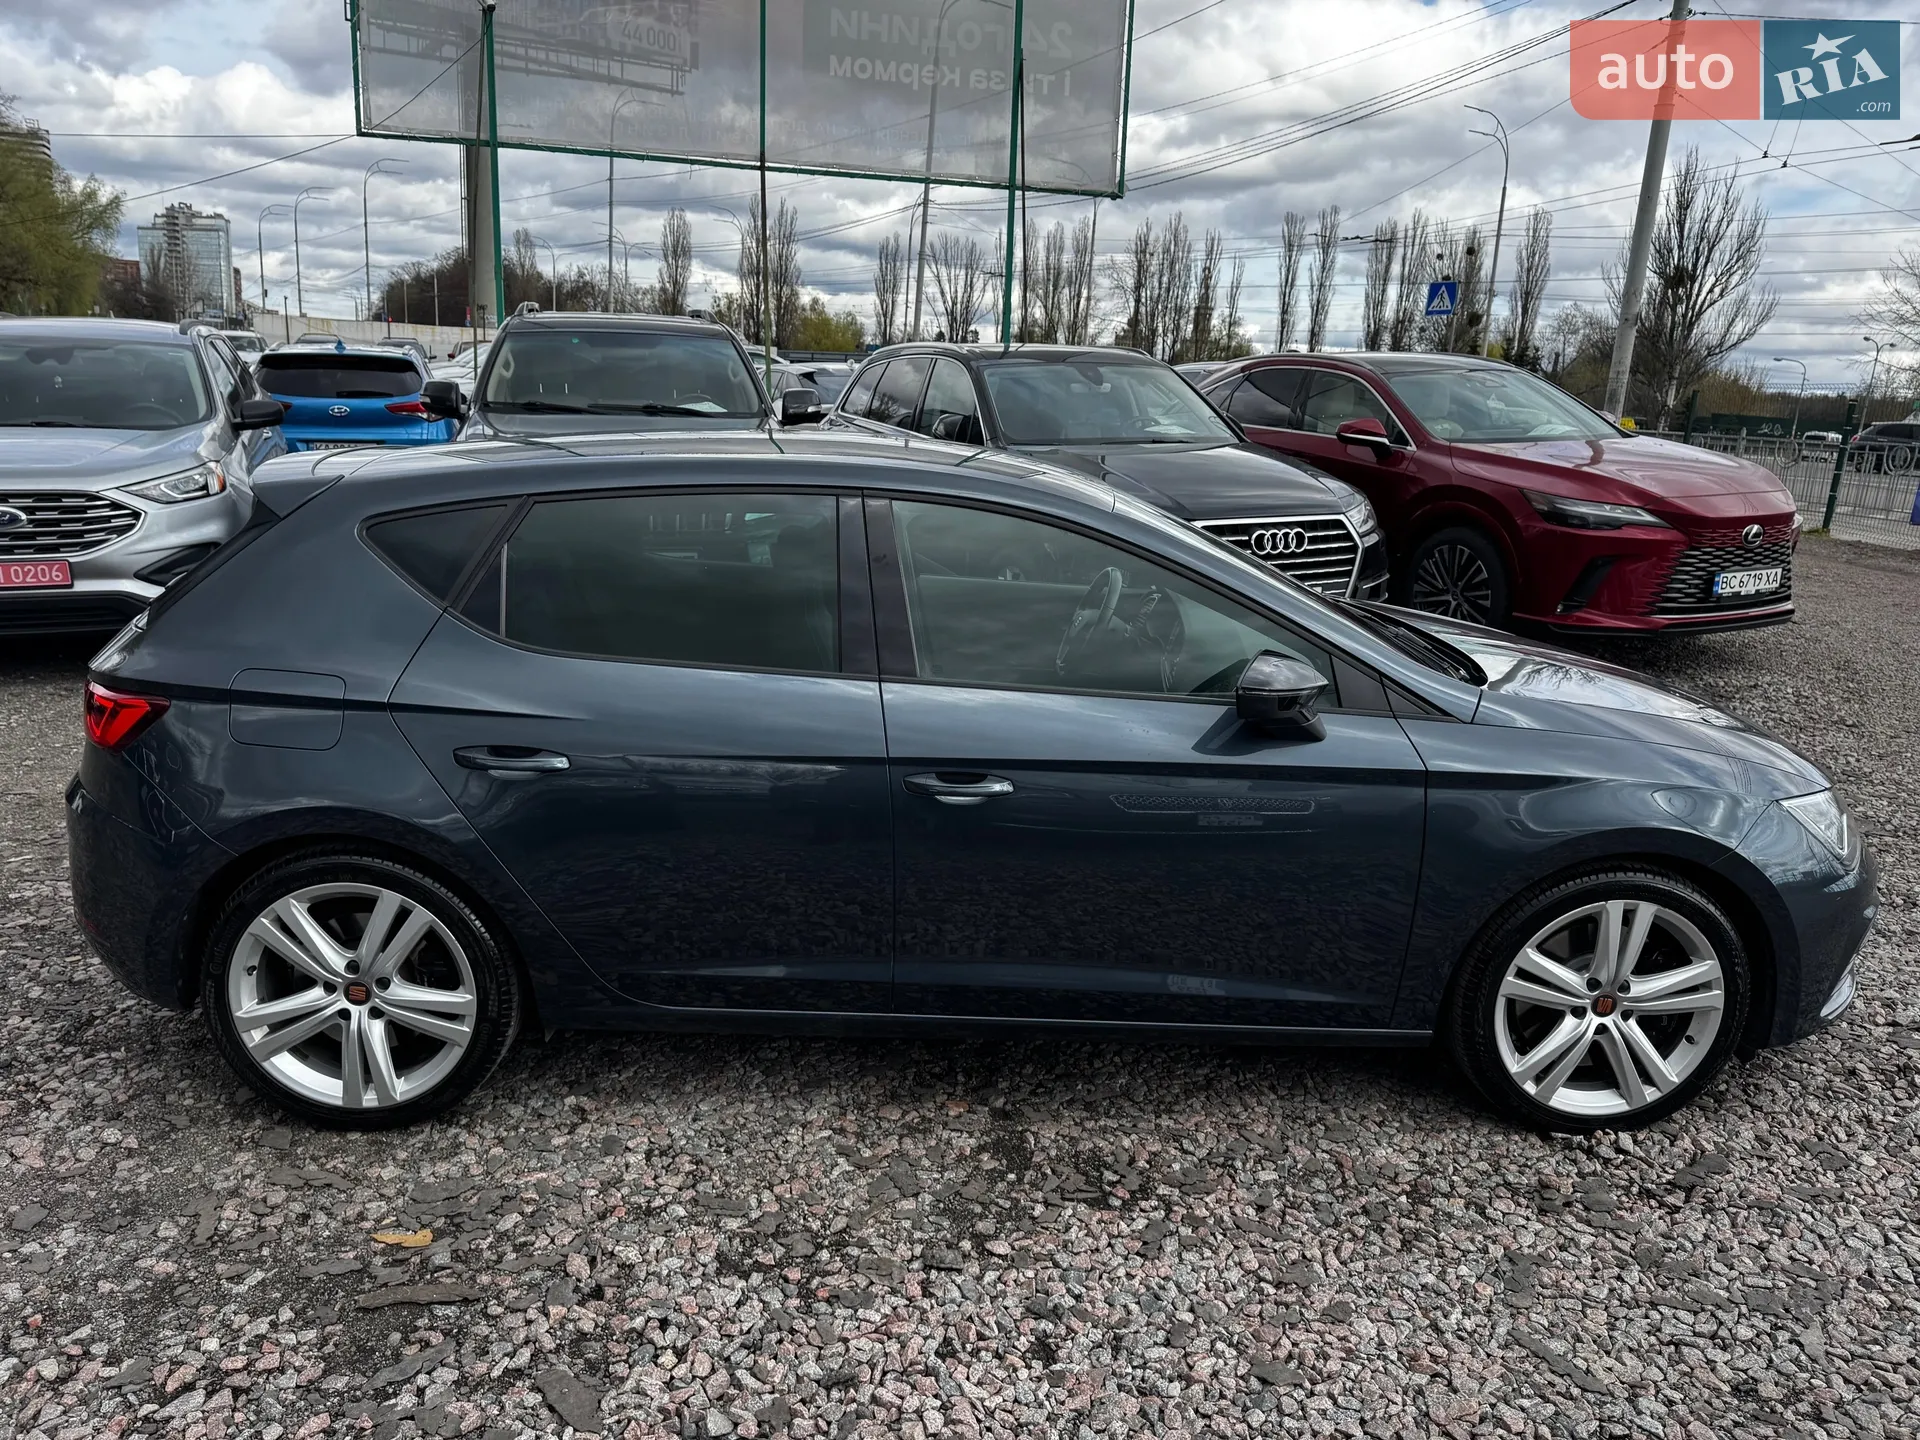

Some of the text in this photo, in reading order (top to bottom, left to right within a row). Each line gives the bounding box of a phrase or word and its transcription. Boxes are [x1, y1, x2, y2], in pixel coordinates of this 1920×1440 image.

[10, 564, 63, 583] 0206
[1720, 571, 1778, 590] BC 6719 XA
